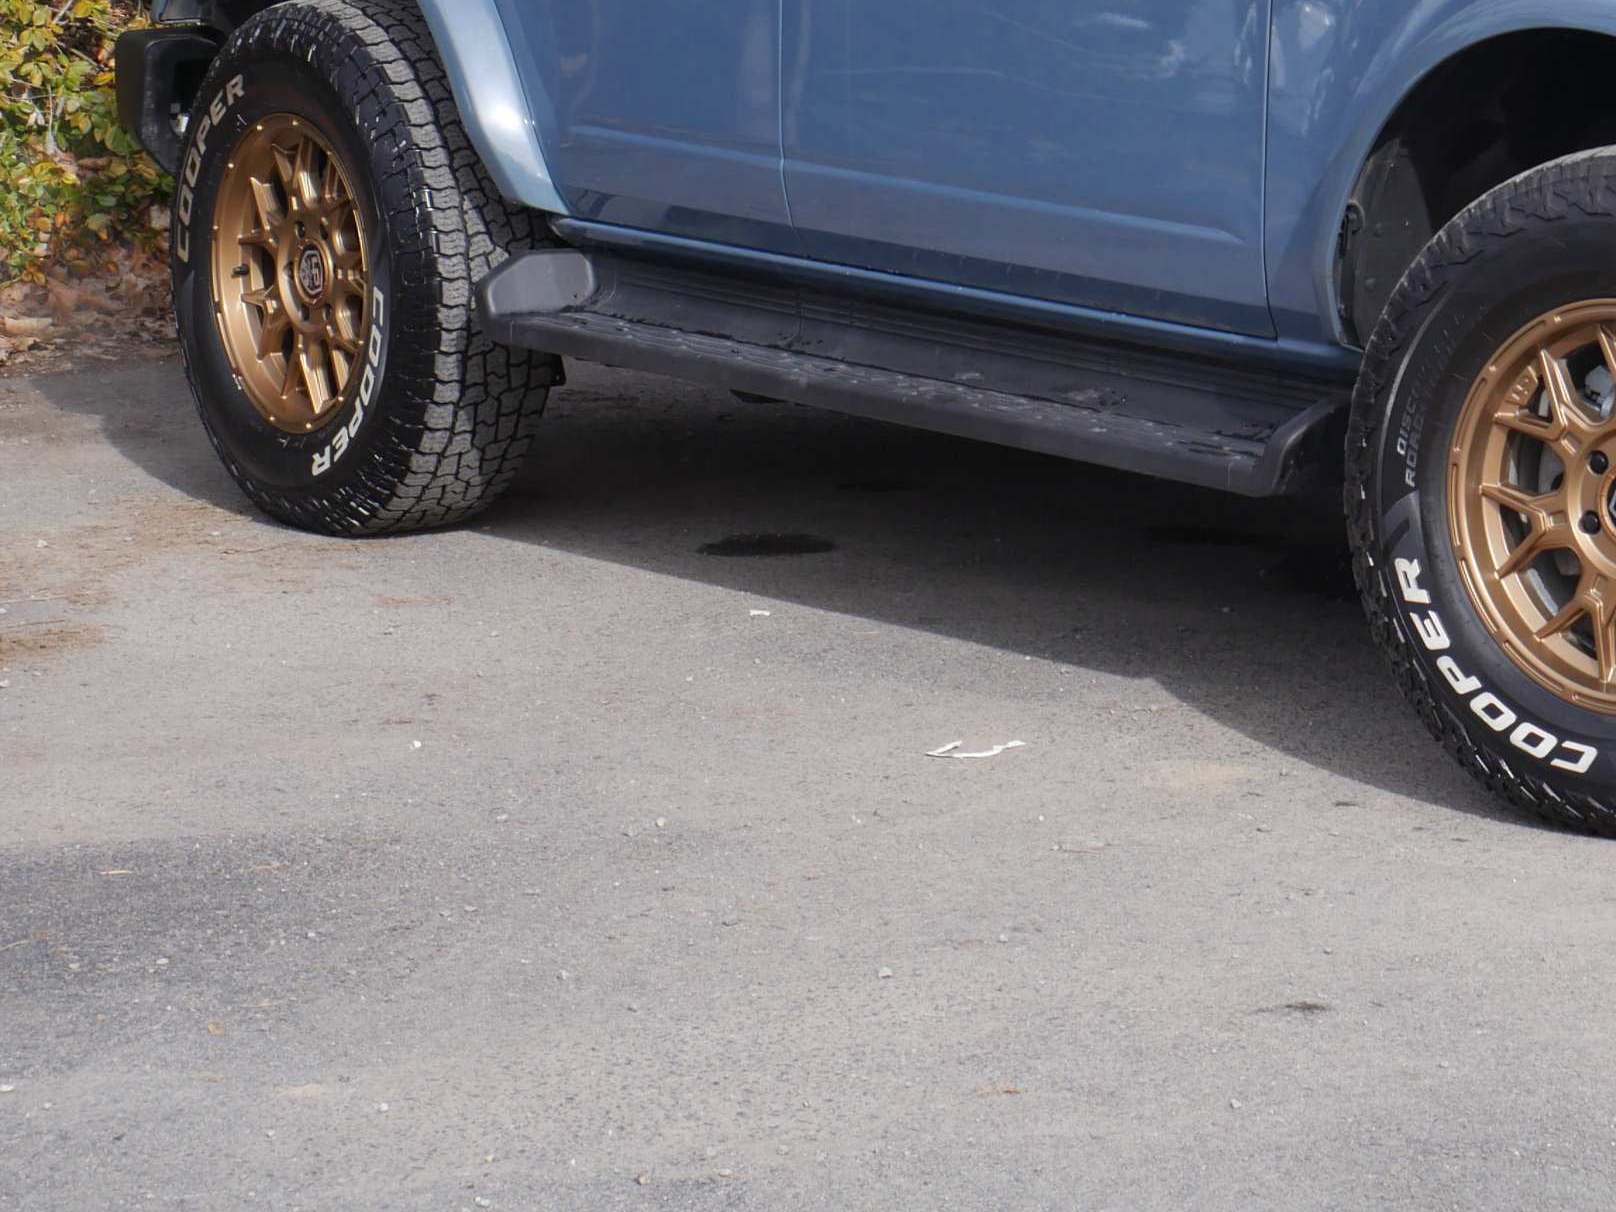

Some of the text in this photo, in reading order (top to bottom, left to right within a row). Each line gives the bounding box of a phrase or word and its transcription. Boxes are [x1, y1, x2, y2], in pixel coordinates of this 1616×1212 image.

[178, 74, 244, 263] COOPER
[312, 286, 384, 477] COOPER
[1394, 557, 1598, 773] COOPER
